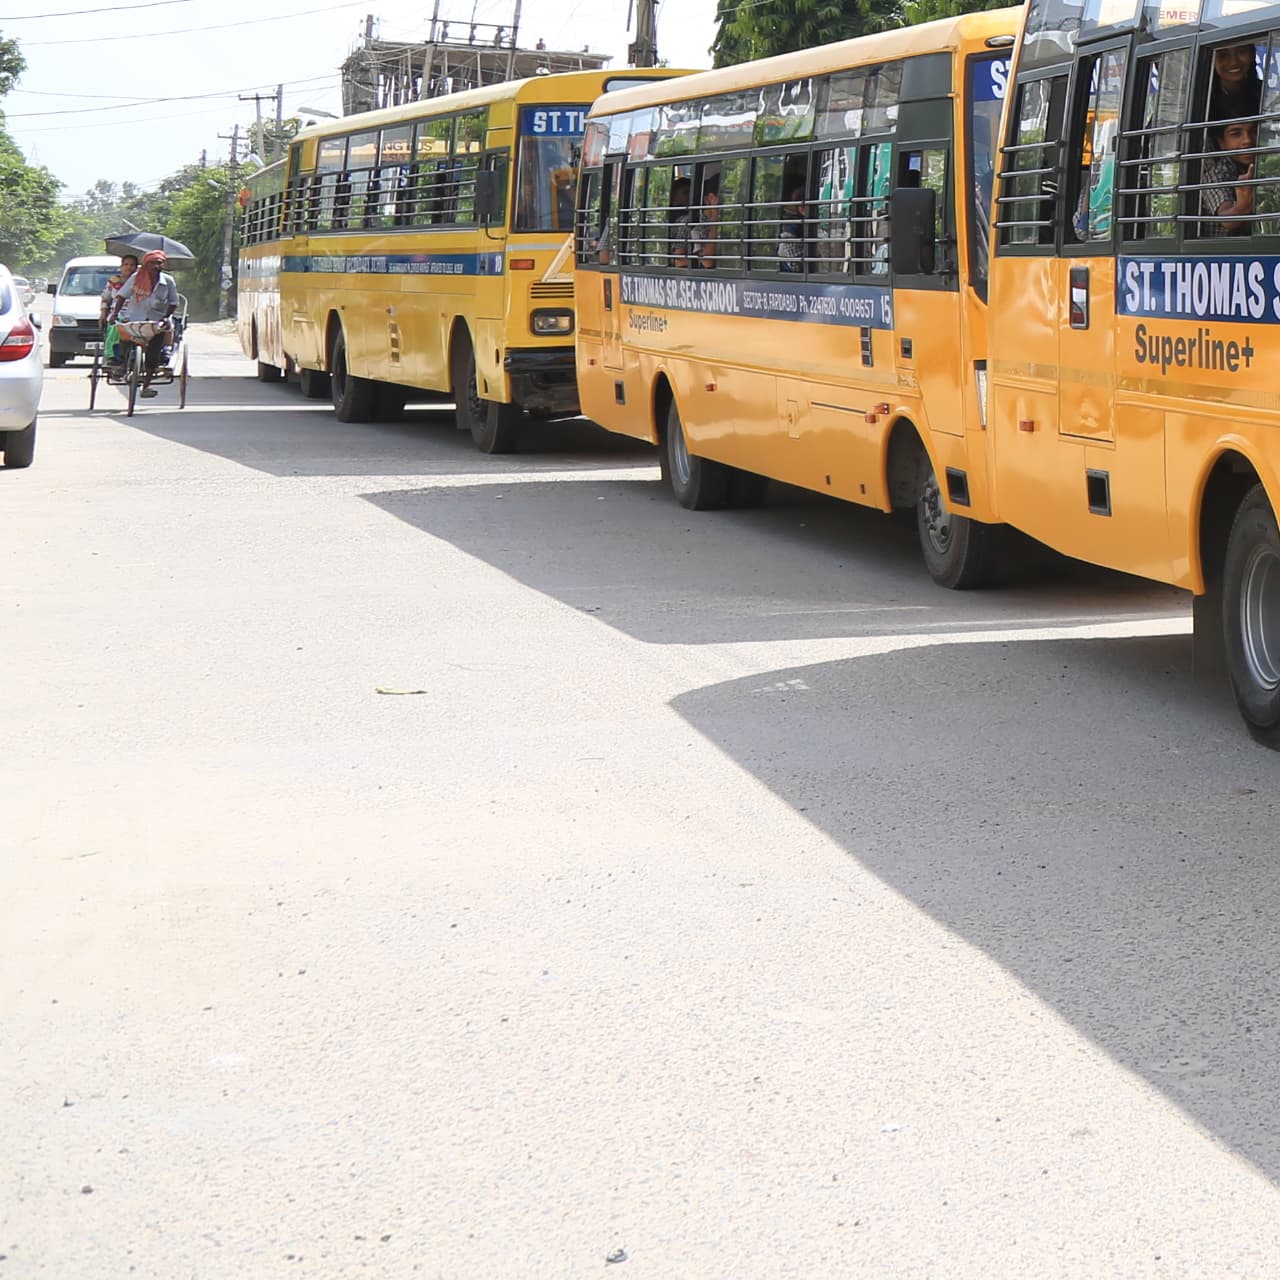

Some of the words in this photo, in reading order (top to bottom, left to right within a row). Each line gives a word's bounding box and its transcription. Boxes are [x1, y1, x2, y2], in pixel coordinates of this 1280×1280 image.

[990, 60, 1011, 99] S
[840, 297, 874, 319] 4009657
[1134, 323, 1254, 375] Superline+
